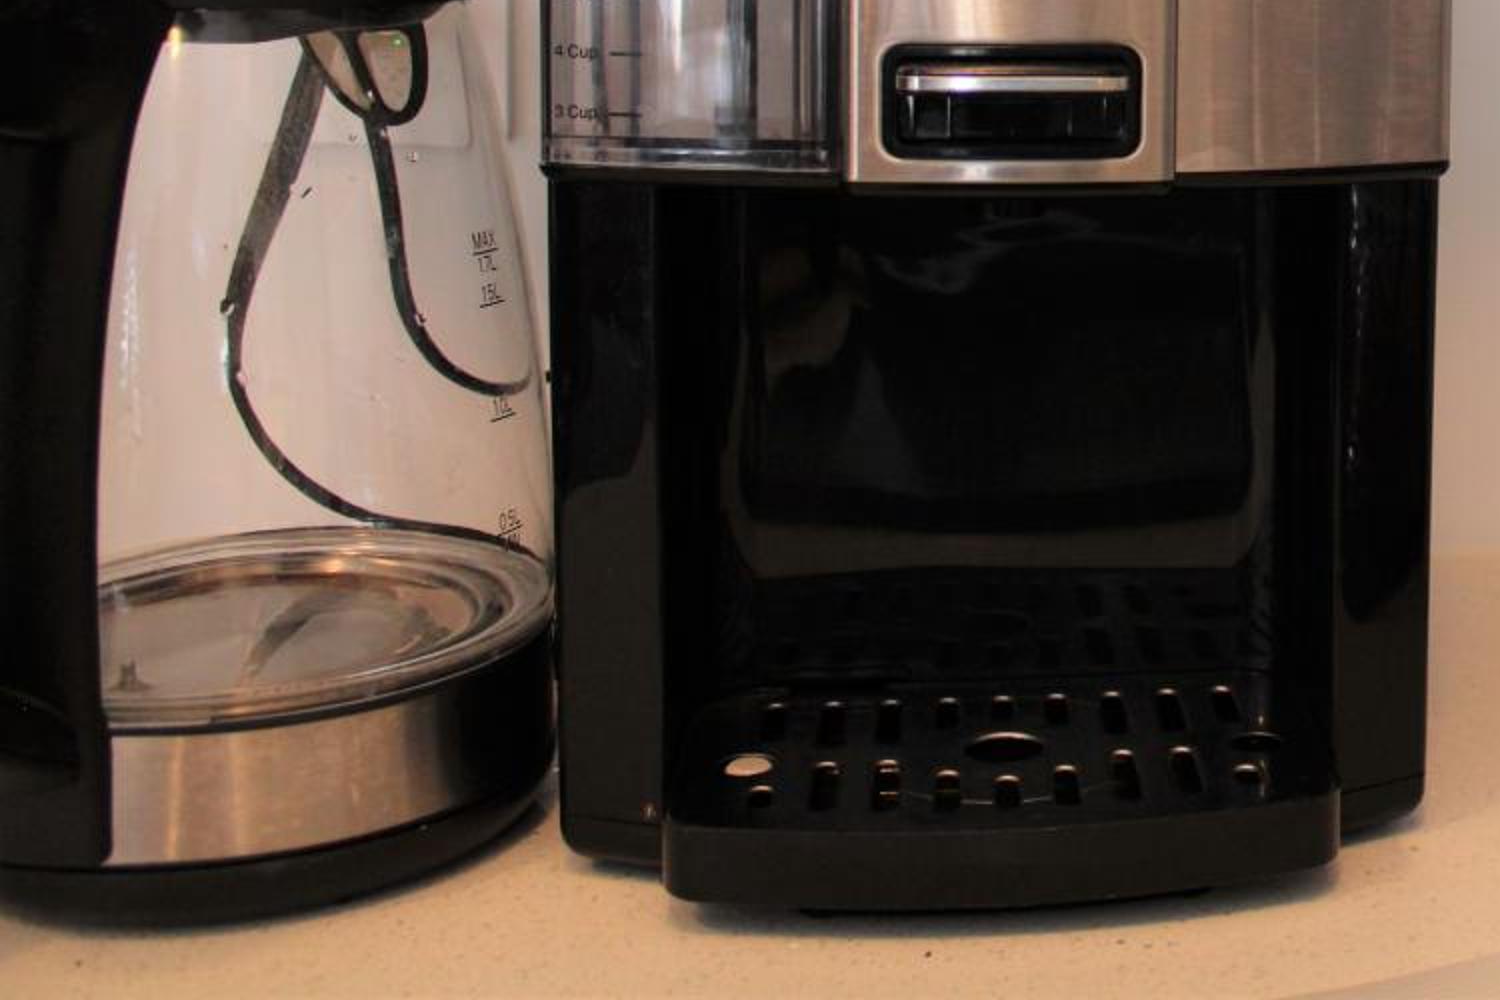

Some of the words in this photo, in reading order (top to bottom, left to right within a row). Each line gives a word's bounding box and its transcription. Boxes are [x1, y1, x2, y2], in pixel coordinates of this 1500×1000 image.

[554, 44, 565, 58] 4
[567, 44, 599, 60] Cup
[554, 105, 565, 119] 3
[567, 104, 599, 121] Cup
[471, 231, 497, 249] MAX
